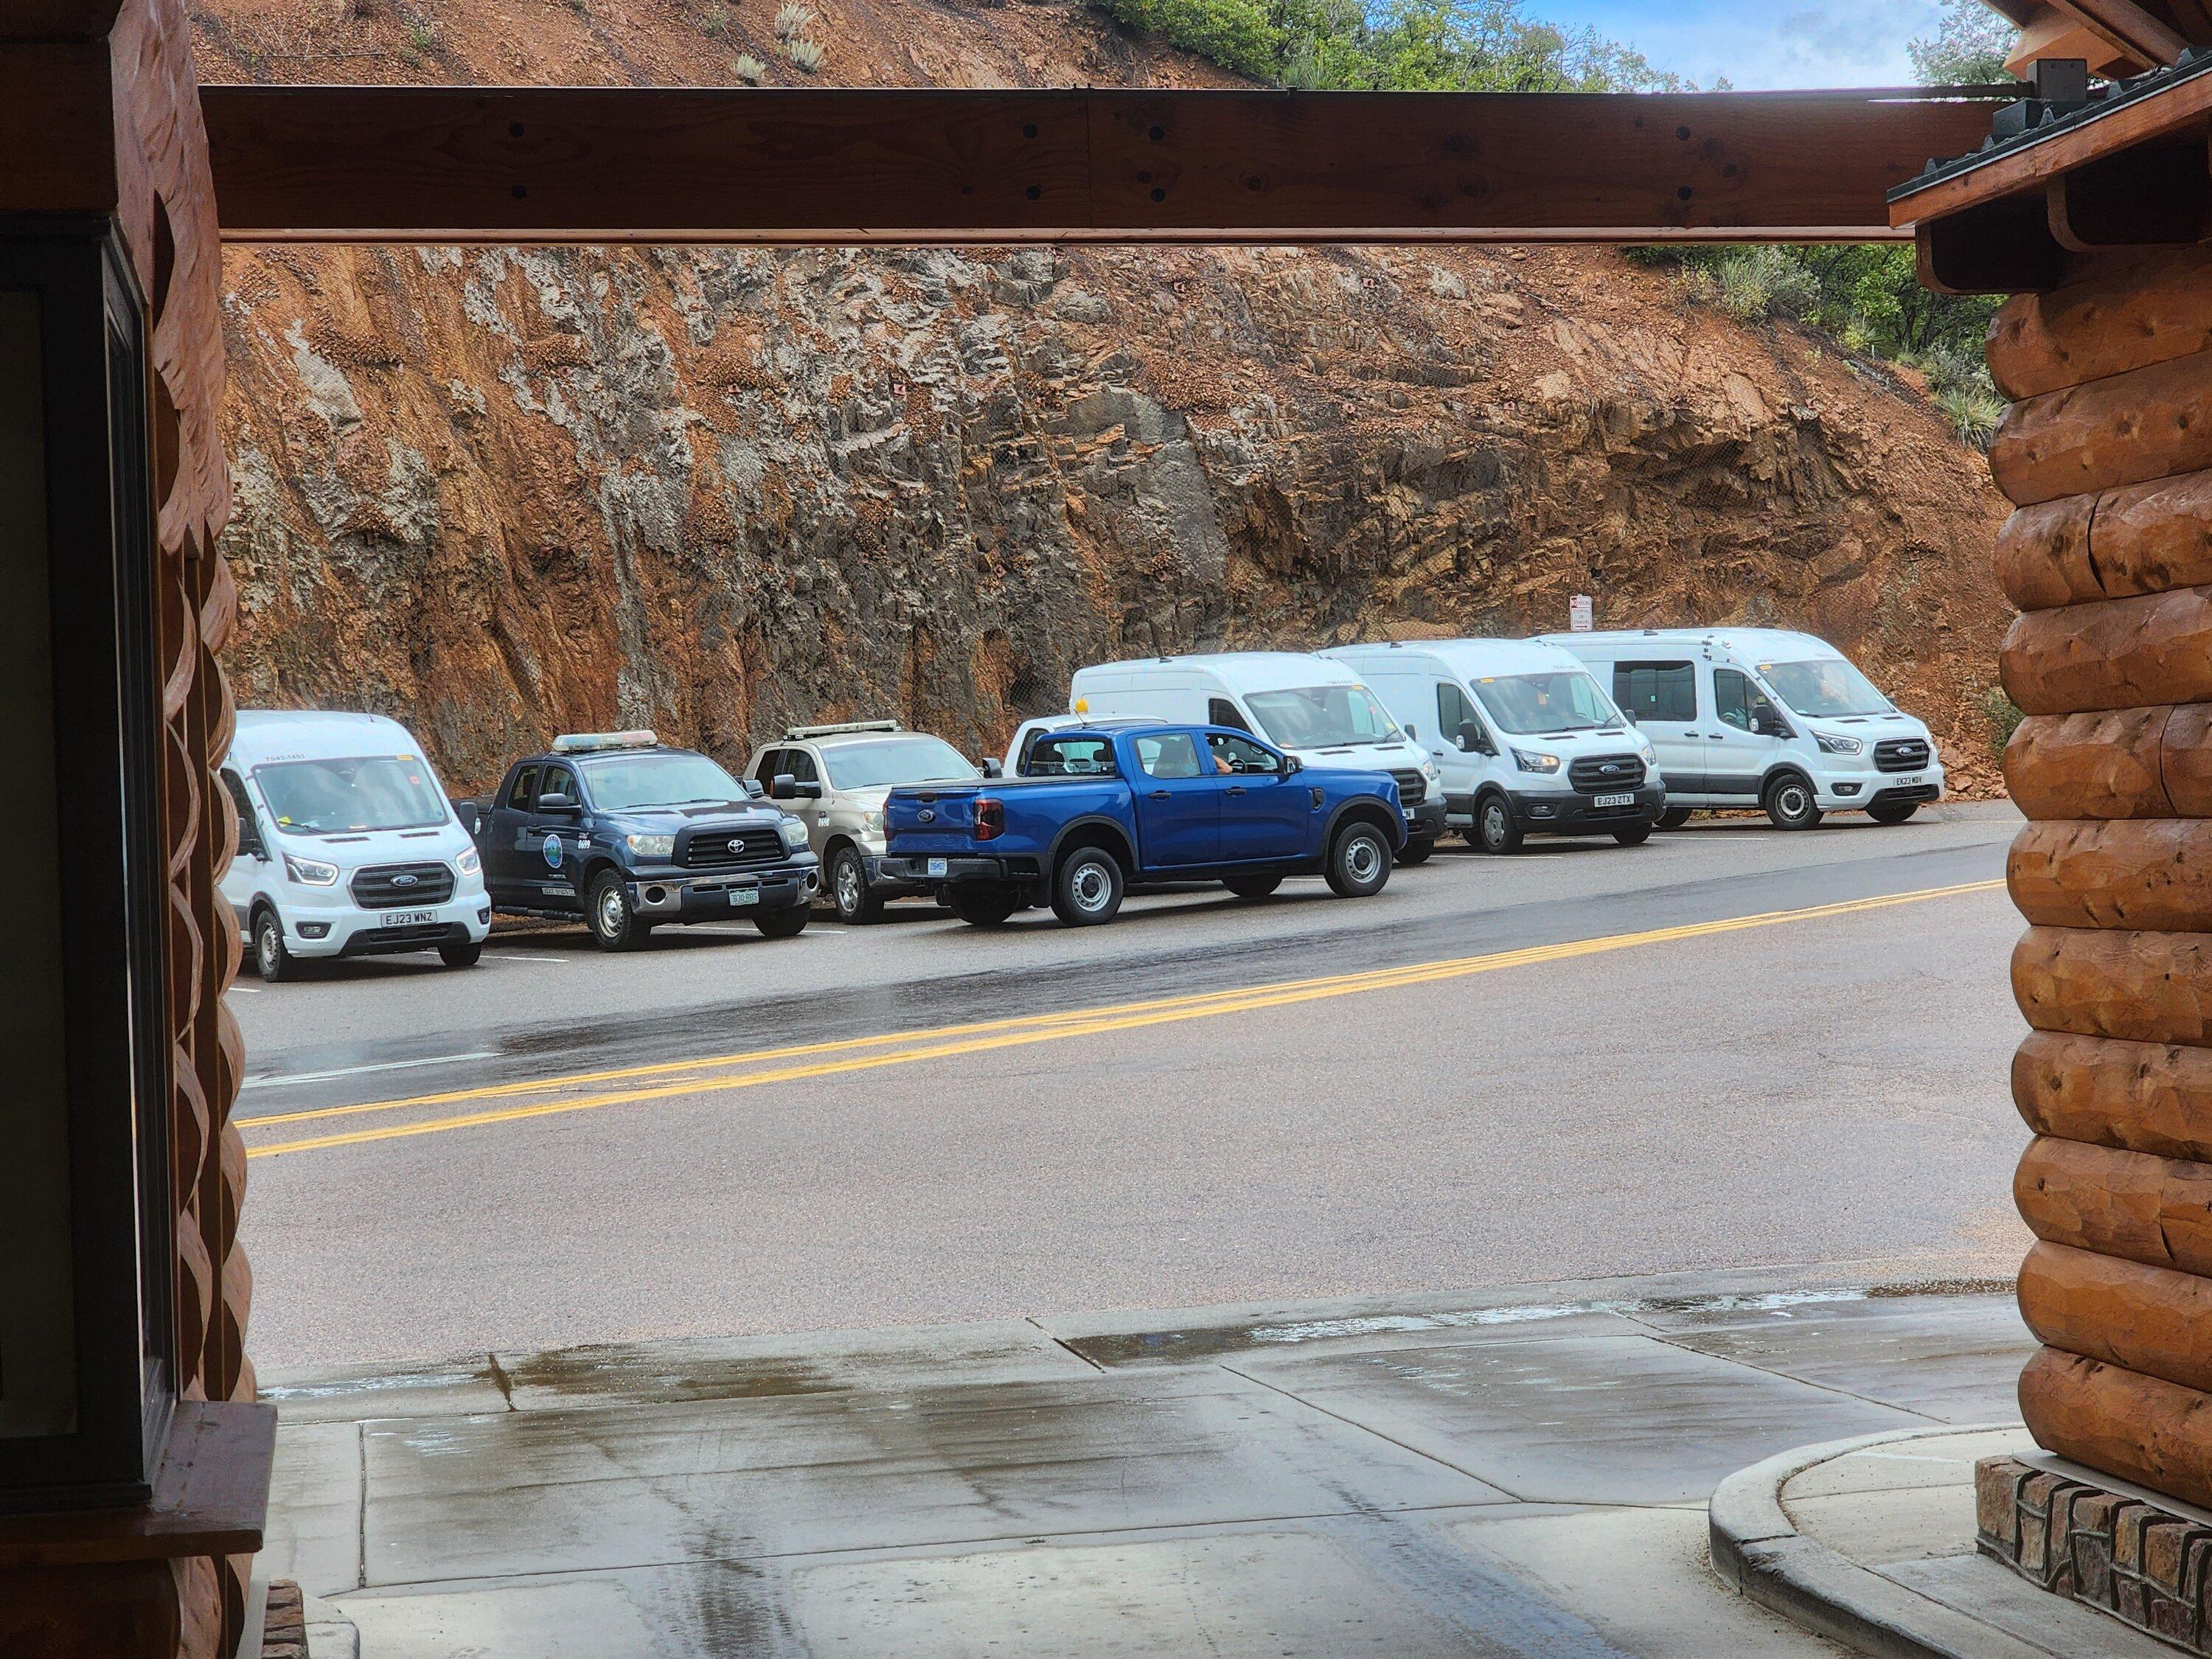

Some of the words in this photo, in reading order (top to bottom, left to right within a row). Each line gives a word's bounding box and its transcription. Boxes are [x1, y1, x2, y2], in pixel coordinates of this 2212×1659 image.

[1597, 797, 1616, 805] EJ23
[1618, 795, 1631, 804] ZTX
[386, 914, 411, 925] EJ23
[414, 912, 433, 922] WNZ
